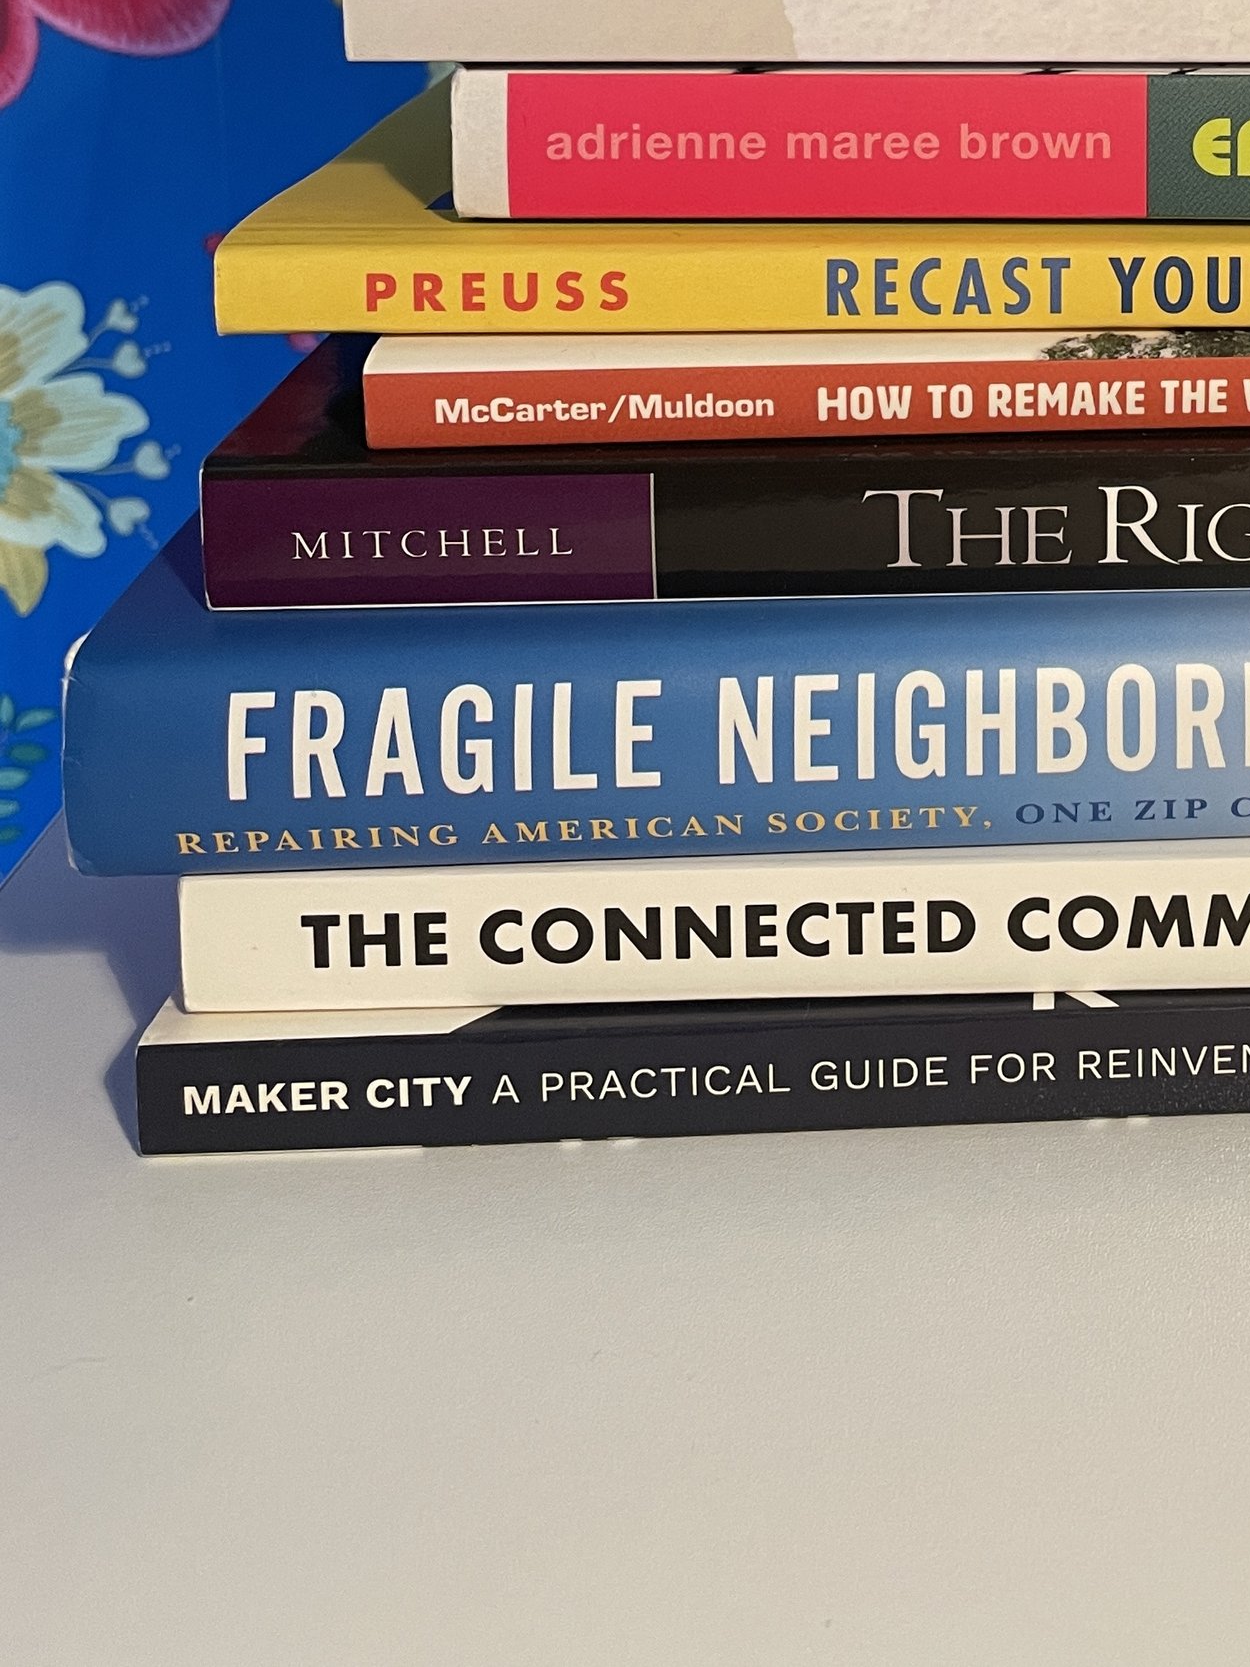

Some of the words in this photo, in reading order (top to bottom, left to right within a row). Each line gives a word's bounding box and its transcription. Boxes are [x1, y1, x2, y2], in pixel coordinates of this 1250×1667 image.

[545, 123, 767, 163] adrienne
[786, 128, 941, 162] maree
[959, 123, 1113, 162] brown
[365, 270, 630, 313] PREUSS
[826, 256, 1072, 317] RECAST
[434, 391, 775, 425] McCarter/Muldoon
[817, 385, 912, 422] HOW
[926, 384, 976, 420] TO
[987, 379, 1146, 418] REMAKE
[1160, 376, 1228, 415] THE
[290, 527, 574, 562] MITCHELL
[862, 488, 1073, 568] THE
[227, 679, 664, 801] FRAGILE
[176, 823, 459, 856] REPAIRING
[481, 813, 746, 846] AMERICAN
[767, 804, 993, 835] SOCIETY,
[1014, 799, 1113, 825] ONE
[1134, 796, 1210, 822] ZIP
[301, 911, 448, 969] THE
[480, 898, 976, 966] CONNECTED
[183, 1079, 349, 1116] MAKER
[366, 1074, 472, 1109] CITY
[491, 1074, 520, 1105] A
[541, 1063, 791, 1104] PRACTICAL
[811, 1056, 949, 1092] GUIDE
[970, 1053, 1057, 1086] FOR
